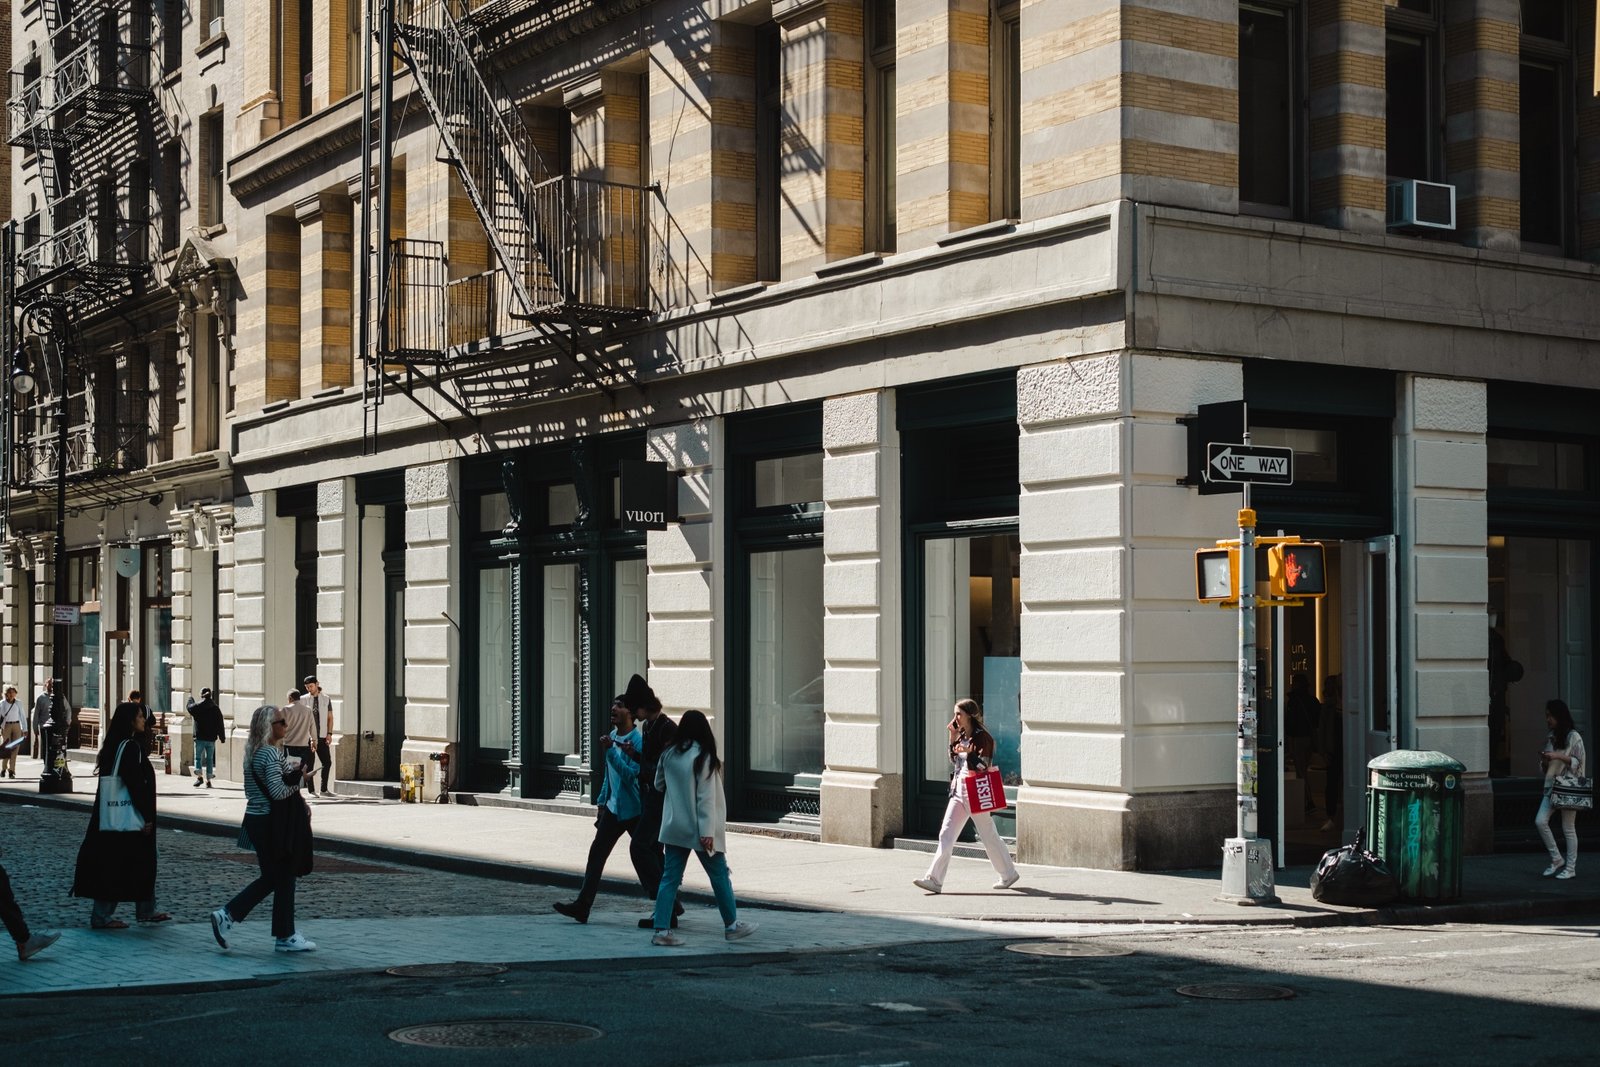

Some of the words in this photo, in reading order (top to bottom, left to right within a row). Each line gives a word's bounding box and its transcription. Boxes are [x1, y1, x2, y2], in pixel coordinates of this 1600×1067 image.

[1220, 456, 1245, 471] ONE
[1258, 458, 1285, 473] WAY
[626, 510, 665, 523] vuori
[1291, 644, 1306, 654] un.
[1291, 658, 1308, 670] urf.
[1385, 772, 1400, 780] Keep
[1400, 772, 1426, 780] Council
[1382, 780, 1403, 788] District
[976, 774, 993, 810] DIESEL
